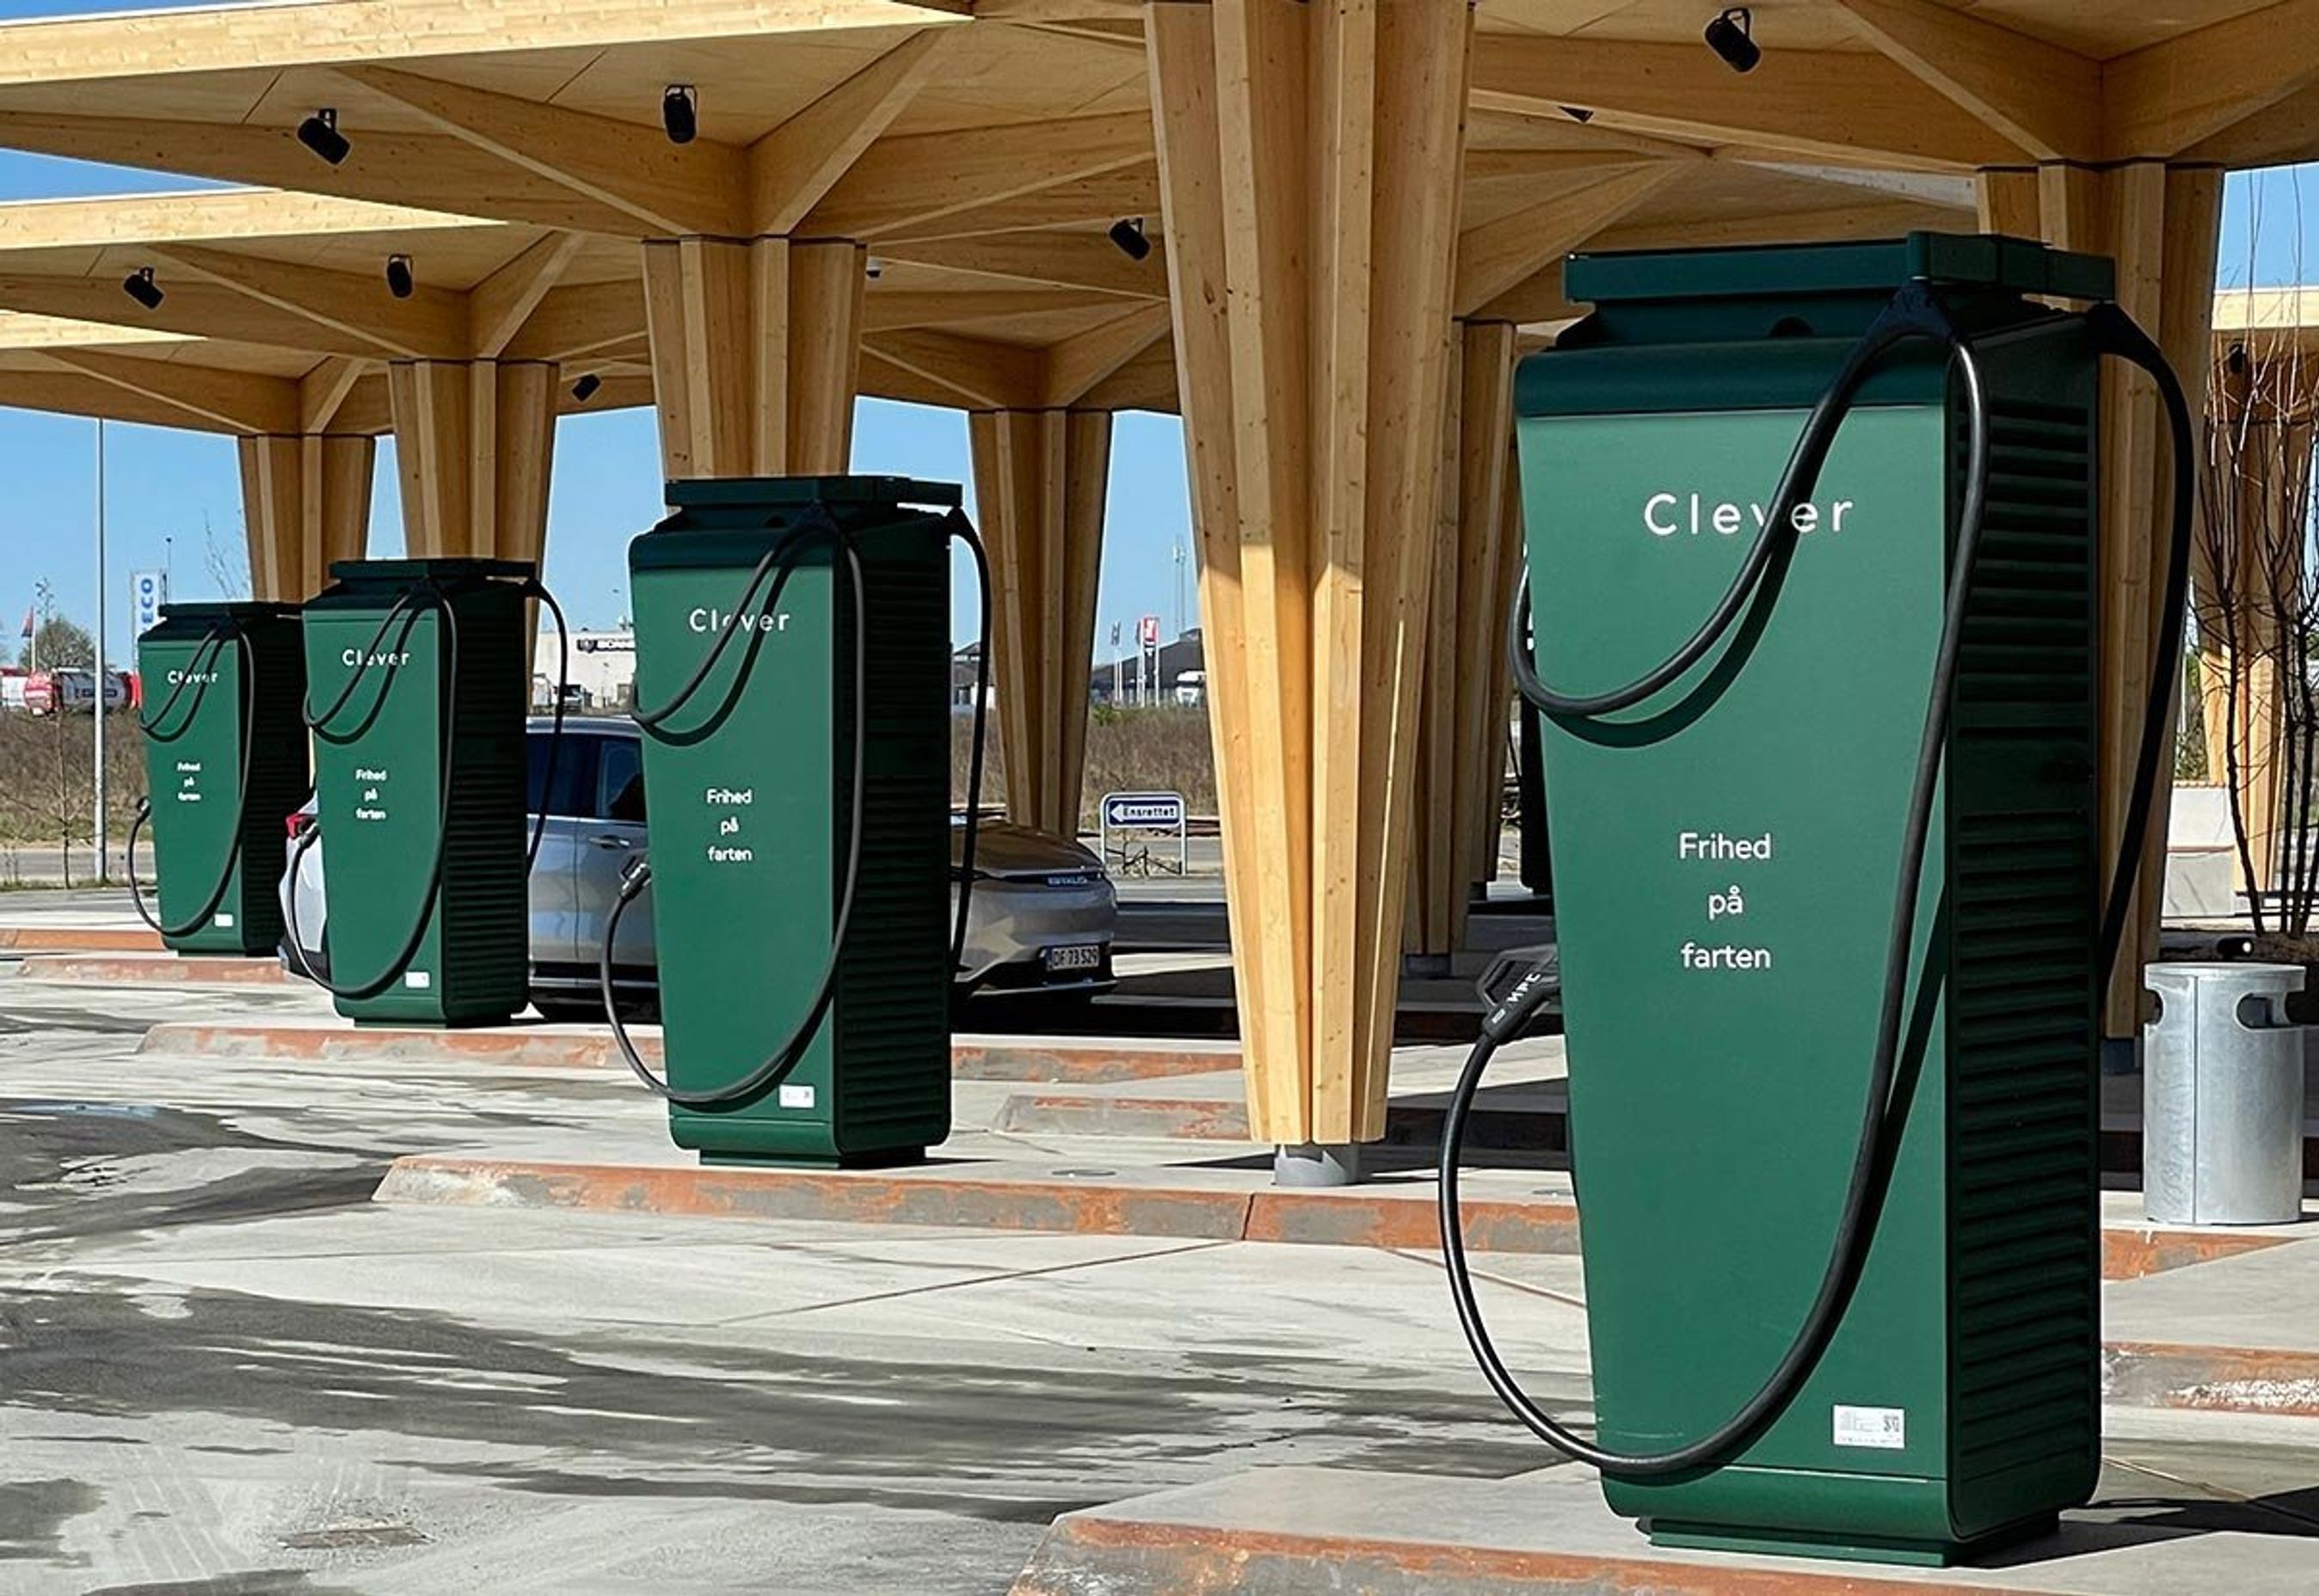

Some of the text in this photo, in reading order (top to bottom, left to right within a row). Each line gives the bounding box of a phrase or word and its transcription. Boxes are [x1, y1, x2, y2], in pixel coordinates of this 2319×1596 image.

[707, 789, 752, 804] Frihed
[721, 817, 739, 836] på
[707, 846, 752, 862] farten
[1679, 832, 1771, 860] Frihed
[1708, 885, 1744, 920] på
[1681, 942, 1771, 969] farten
